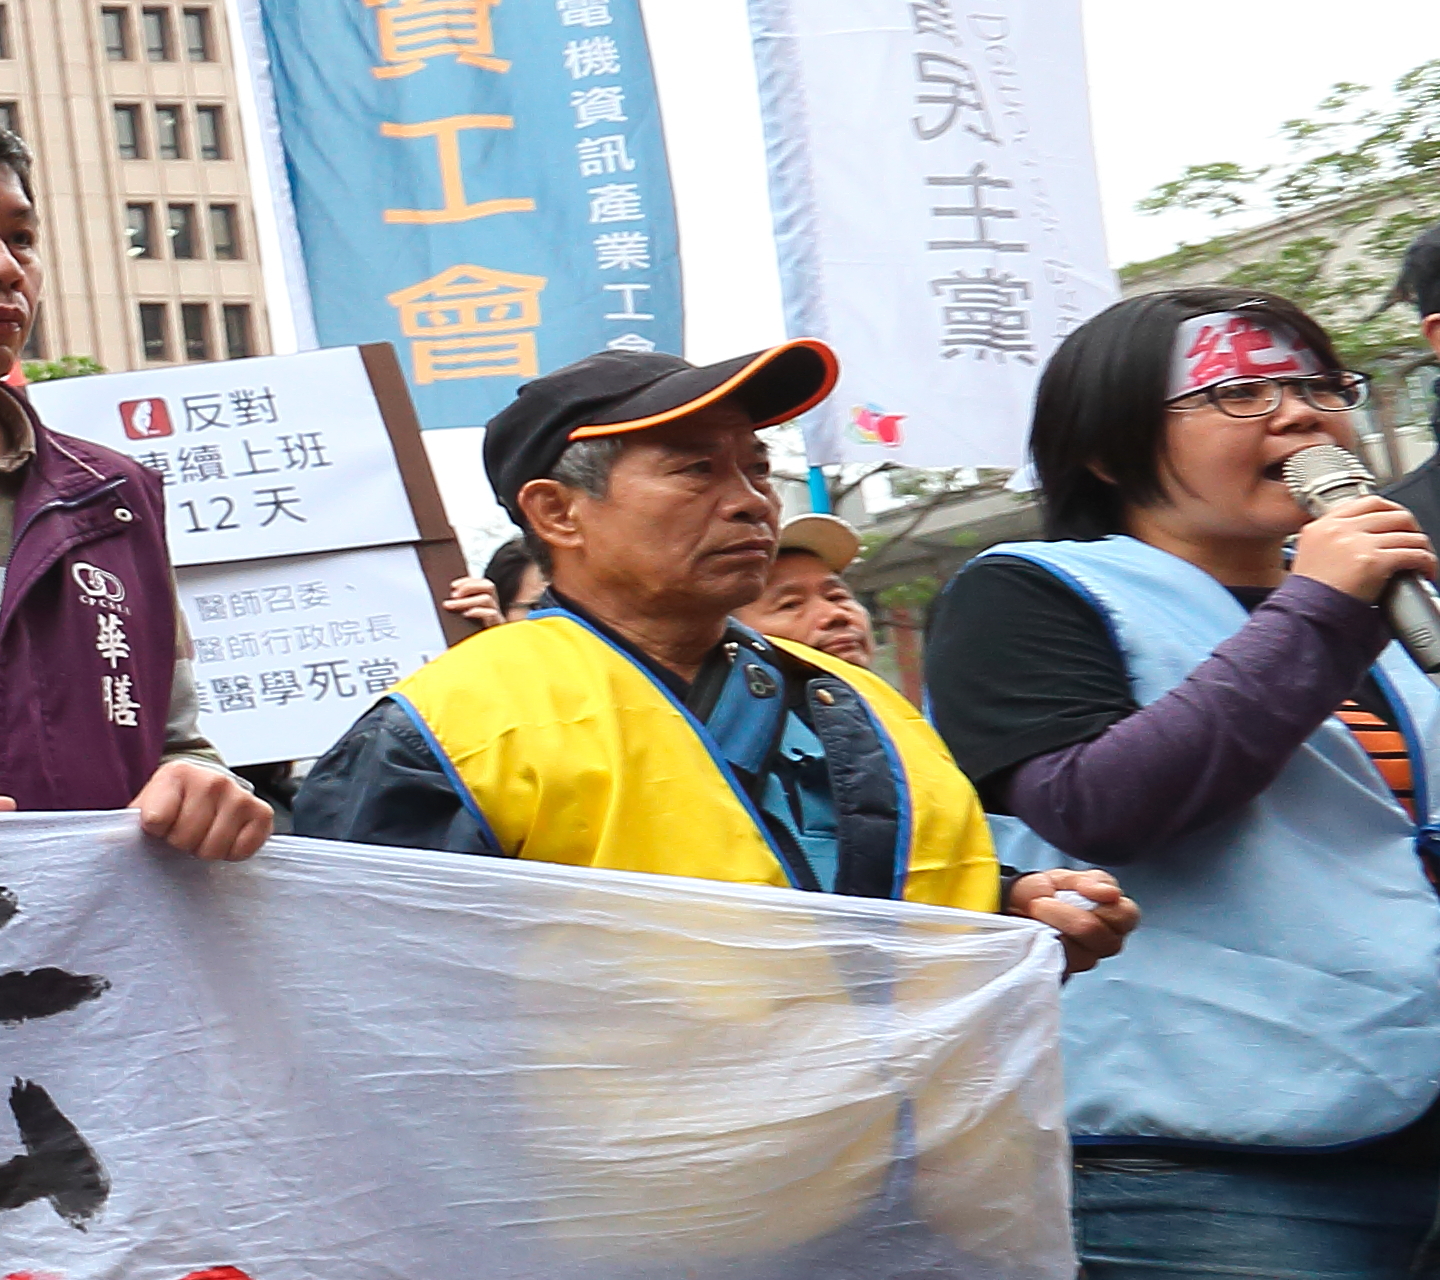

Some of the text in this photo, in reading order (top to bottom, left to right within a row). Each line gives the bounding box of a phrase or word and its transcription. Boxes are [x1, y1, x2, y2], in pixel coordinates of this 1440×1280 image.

[182, 386, 278, 433] 反對
[140, 431, 333, 488] 連續上班
[194, 614, 400, 665] 醫師行政院長
[96, 612, 141, 726] 華膳
